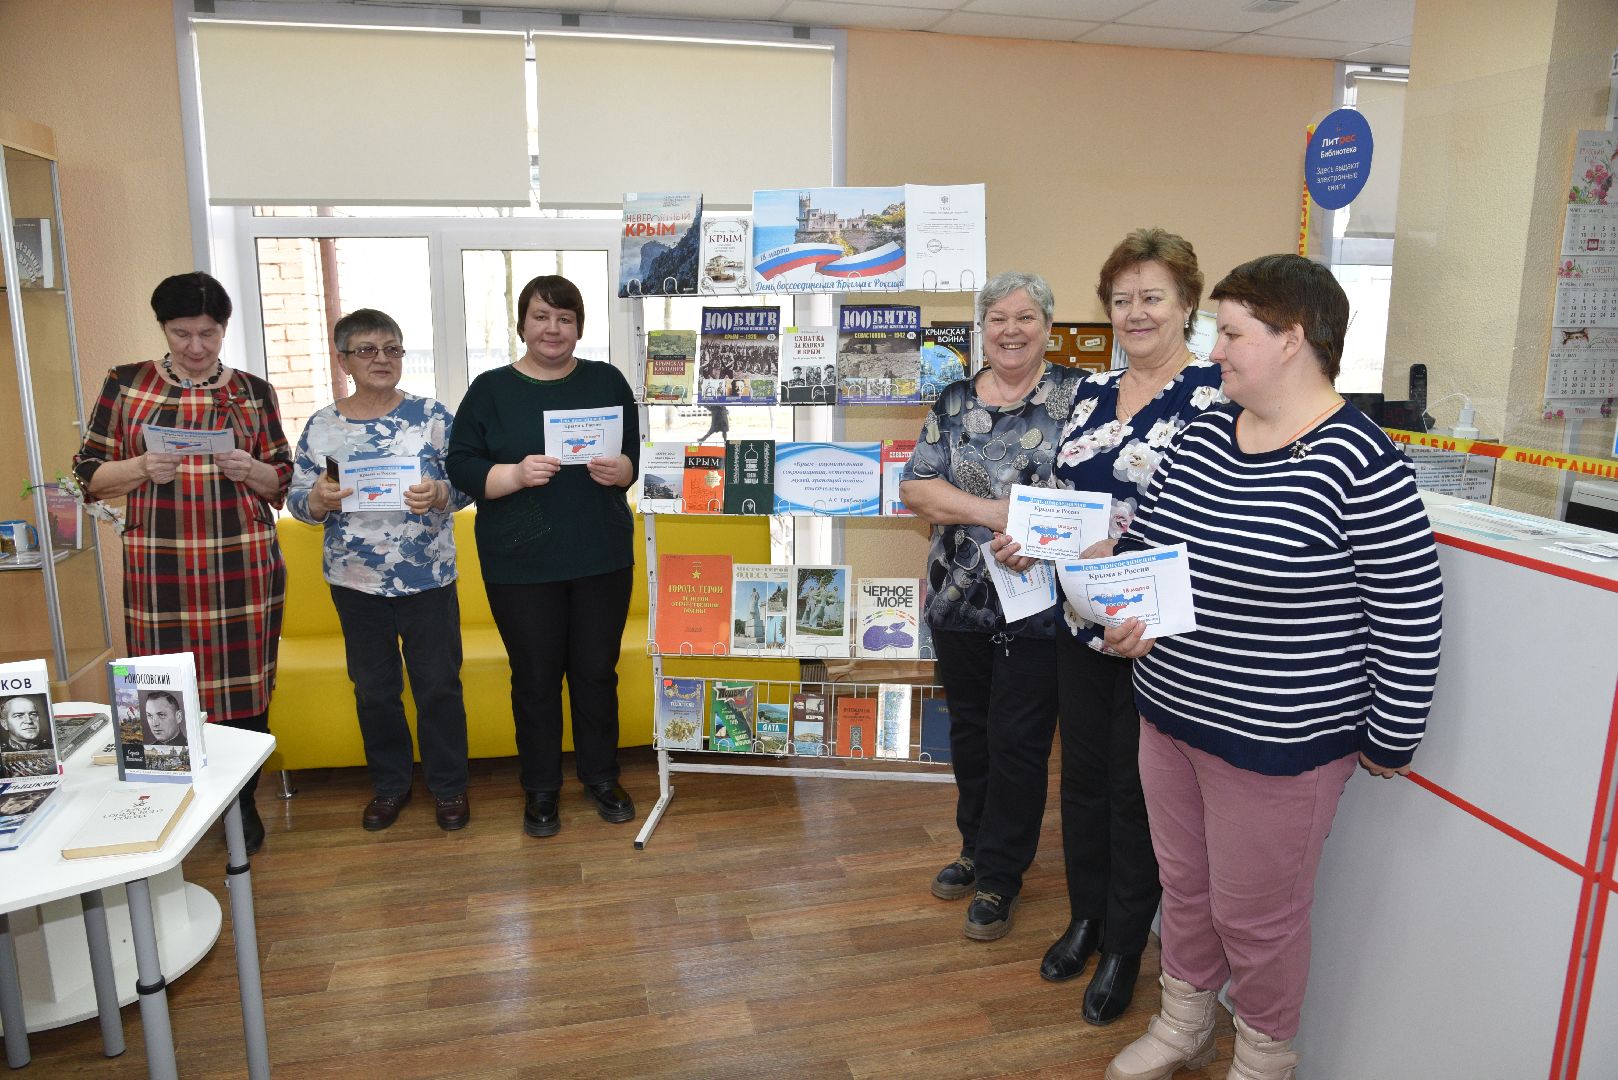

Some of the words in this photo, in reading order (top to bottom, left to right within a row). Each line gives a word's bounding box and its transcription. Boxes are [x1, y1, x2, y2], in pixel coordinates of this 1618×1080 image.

[1320, 146, 1357, 158] Библиотека
[1316, 166, 1334, 174] Здесь
[1335, 162, 1360, 172] выдают
[1316, 172, 1358, 184] электронные
[625, 222, 676, 237] КРЫМ
[709, 234, 742, 242] КРЫМ
[768, 247, 790, 258] марта
[756, 282, 774, 292] День
[836, 280, 866, 292] Крыма
[874, 280, 905, 289] Россией
[705, 312, 733, 331] 100
[734, 312, 777, 326] БИТВ
[843, 310, 872, 329] 100
[872, 310, 917, 324] БИТВ
[688, 458, 719, 466] КРЫМ
[1088, 572, 1115, 580] Крыма
[1124, 566, 1150, 575] России
[668, 585, 696, 593] ГОРОДА
[864, 585, 914, 597] ЧЕРНОЕ
[877, 597, 913, 608] МОРЕ
